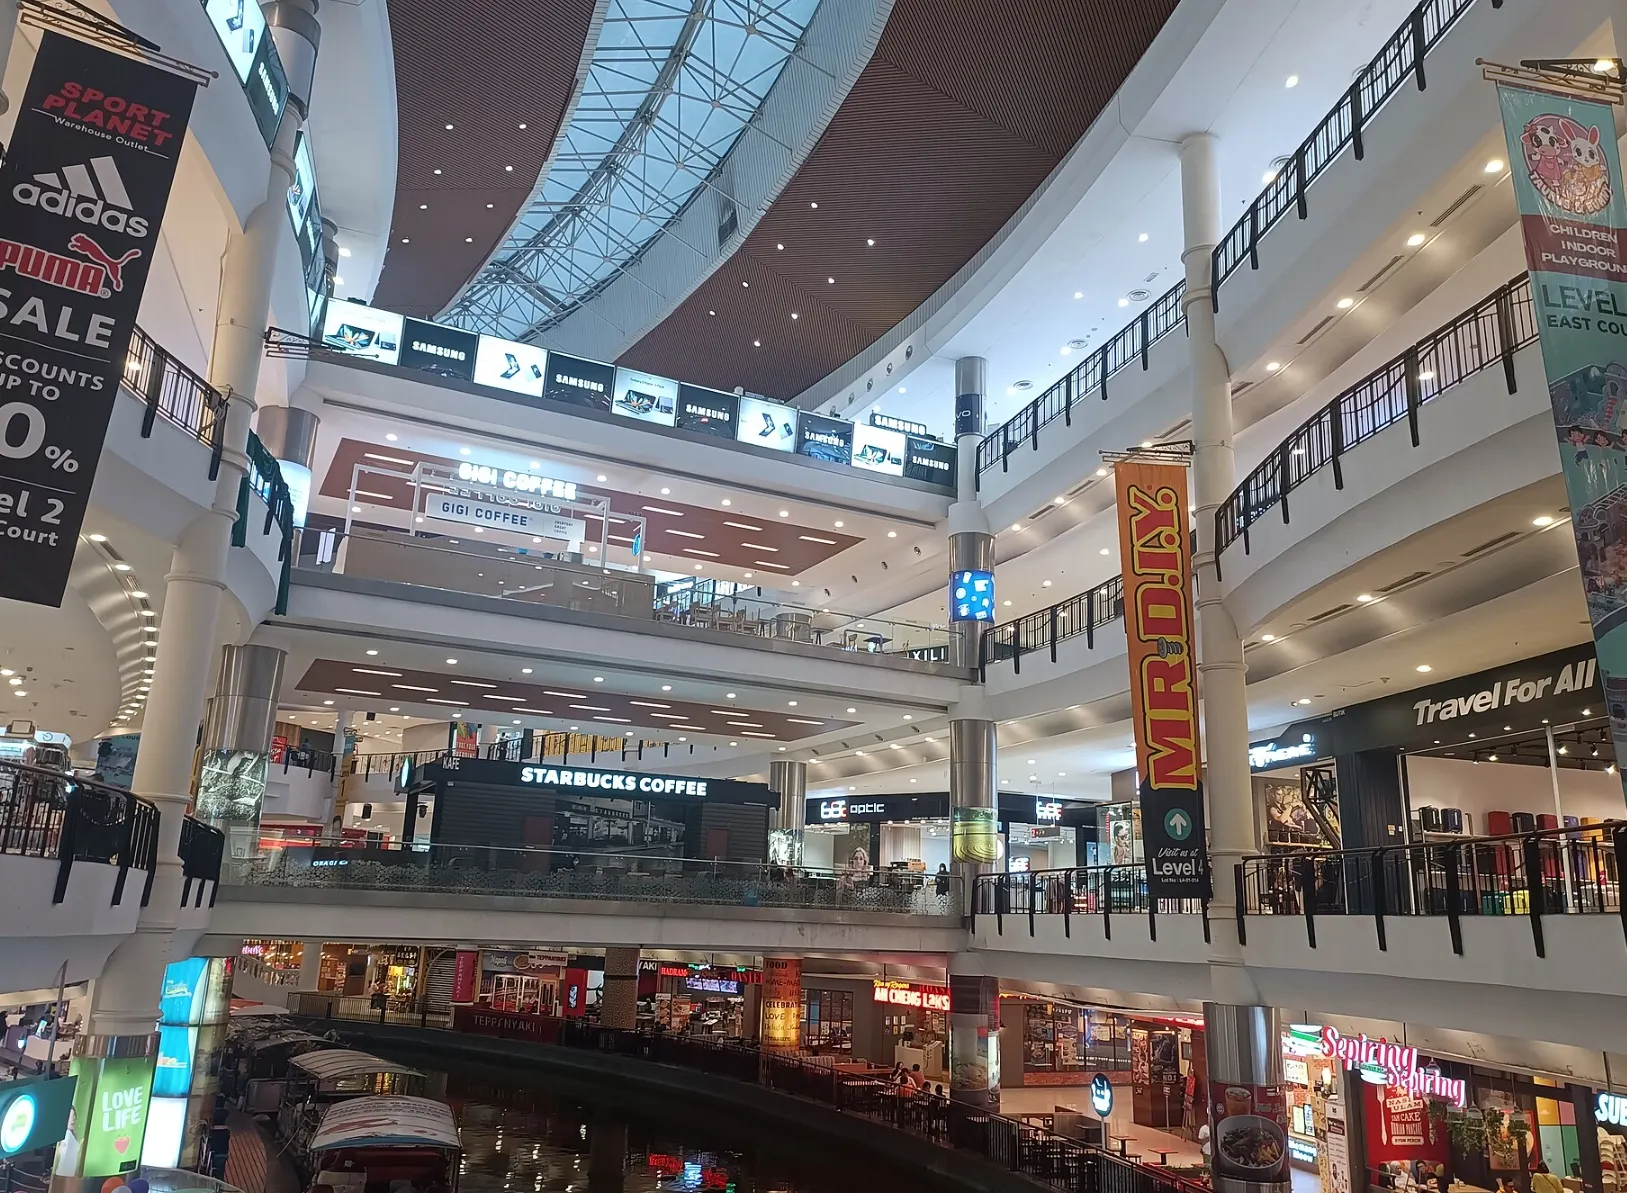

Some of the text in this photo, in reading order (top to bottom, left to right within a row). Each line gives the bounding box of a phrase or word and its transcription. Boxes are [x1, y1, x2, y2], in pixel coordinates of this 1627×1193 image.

[258, 62, 279, 115] SAMSUNG
[61, 82, 171, 126] SPORT
[42, 94, 172, 146] PLANET
[54, 115, 149, 152] Warehouse Outlet
[12, 182, 149, 237] adidas
[1550, 224, 1618, 243] CHILDREN
[1561, 240, 1616, 257] INDOOR
[0, 238, 106, 297] PUMA
[1541, 285, 1627, 317] LEVEL
[1546, 314, 1591, 331] EAST
[412, 340, 466, 361] SAMSUNG
[29, 380, 60, 401] TO
[555, 373, 604, 392] SAMSUNG
[686, 404, 729, 421] SAMSUNG
[874, 415, 926, 436] SAMSUNG
[804, 431, 844, 447] SAMSUNG
[912, 456, 949, 470] SAMSUNG
[458, 462, 577, 500] GIGI COFFEE
[40, 498, 64, 525] 2
[442, 502, 528, 527] GIGI COFFEE
[1413, 657, 1597, 726] Travel For All
[443, 757, 460, 770] KAFE
[521, 767, 708, 796] STARBUCKS COFFEE
[850, 802, 885, 814] optic
[1158, 847, 1181, 858] Visit
[1190, 848, 1199, 857] at
[1152, 858, 1196, 876] Level
[456, 956, 464, 999] TEPPANYAKI
[874, 988, 888, 1001] AH
[889, 989, 921, 1007] CHENG
[1321, 1025, 1418, 1077] Sepiring
[1387, 1064, 1465, 1108] Sepiring
[102, 1086, 143, 1112] LOVE
[1393, 1101, 1421, 1111] ULAM
[102, 1104, 142, 1132] LIFE
[1400, 1112, 1421, 1122] CAKE
